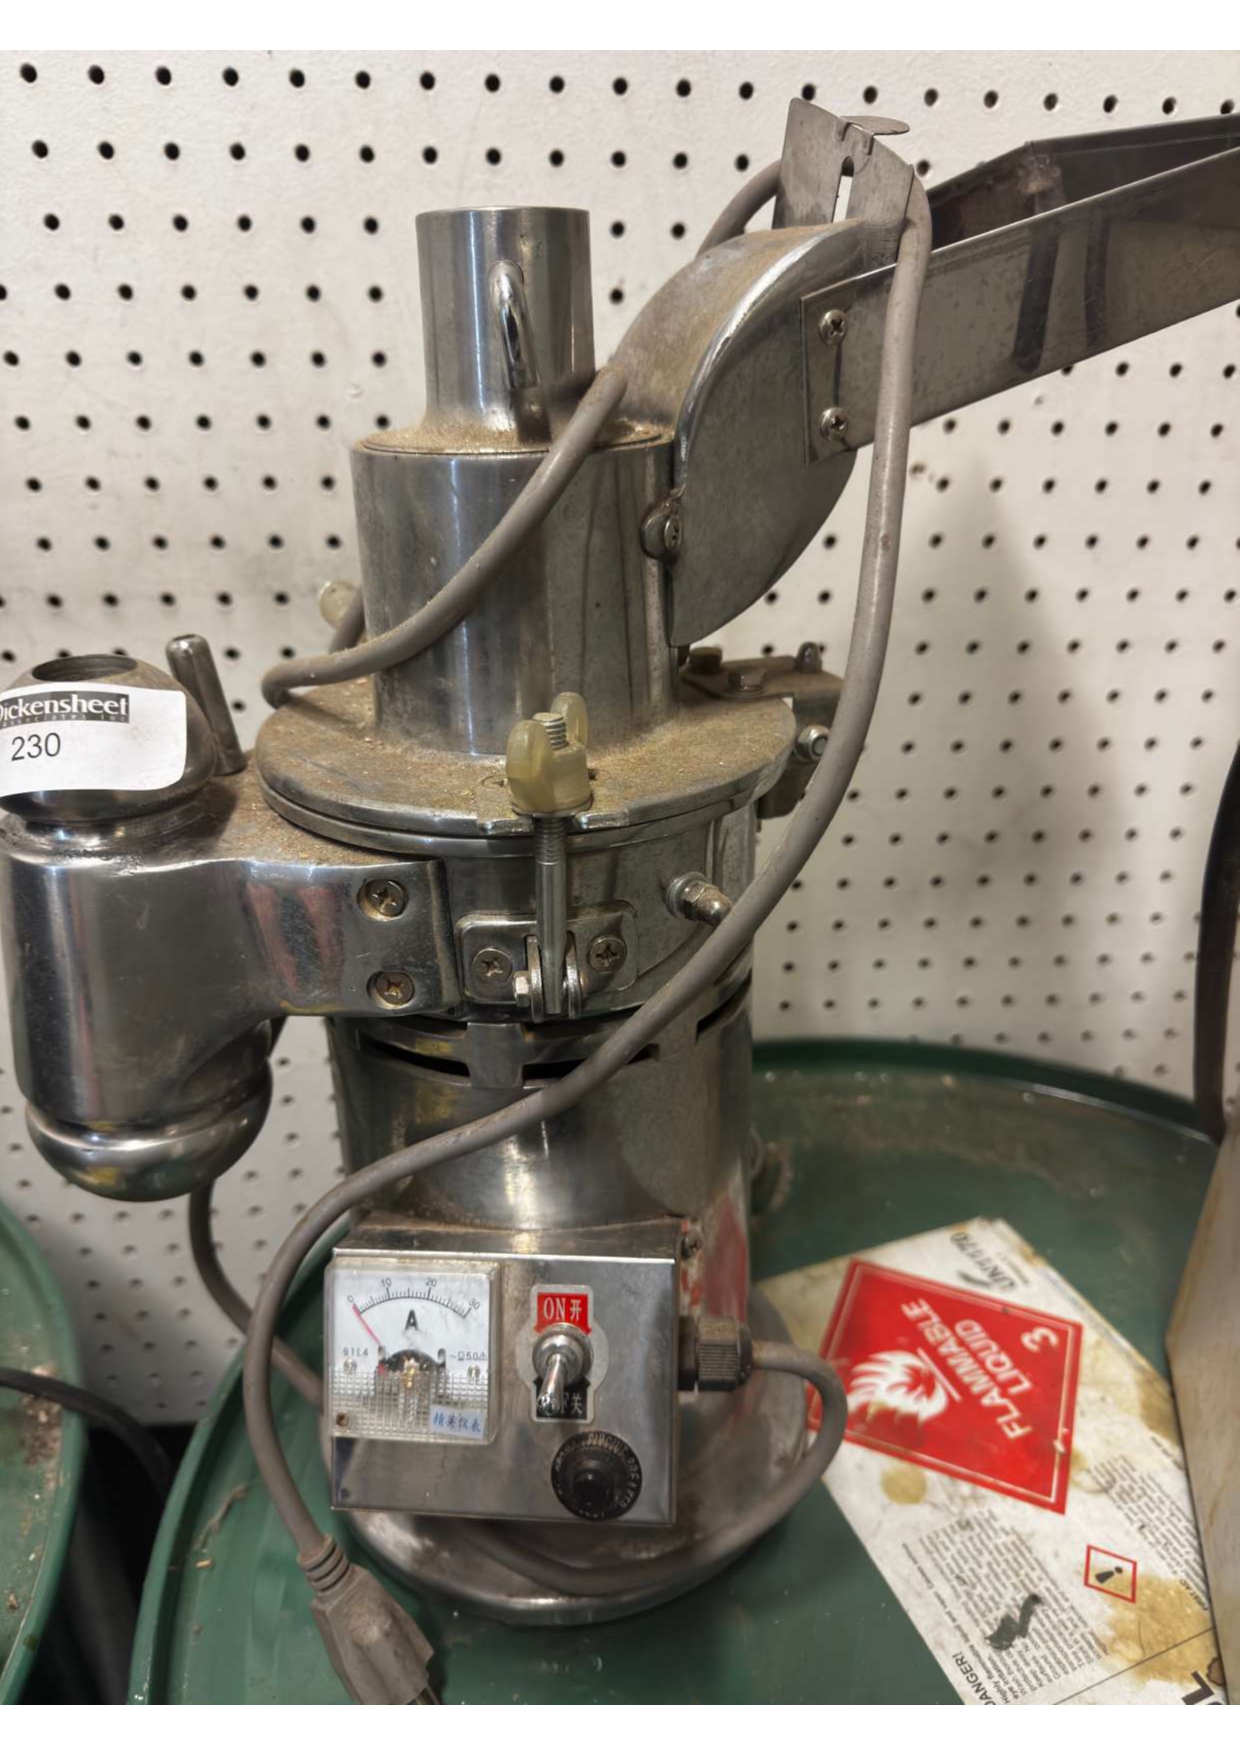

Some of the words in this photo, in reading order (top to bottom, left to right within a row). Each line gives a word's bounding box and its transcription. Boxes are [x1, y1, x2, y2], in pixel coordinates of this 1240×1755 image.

[12, 732, 61, 761] 230
[381, 1277, 391, 1287] 10
[425, 1277, 437, 1287] 20
[468, 1297, 480, 1310] 30
[543, 1297, 566, 1320] ON
[570, 1299, 582, 1321] 开
[405, 1309, 419, 1331] A
[1020, 1327, 1059, 1353] 3
[901, 1298, 1032, 1438] FLAMMABLE
[954, 1319, 1033, 1395] LIQUID
[966, 1644, 995, 1679] flammable
[1028, 1668, 1045, 1687] Keep
[990, 1679, 1012, 1703] Highly
[1006, 1685, 1020, 1699] eye
